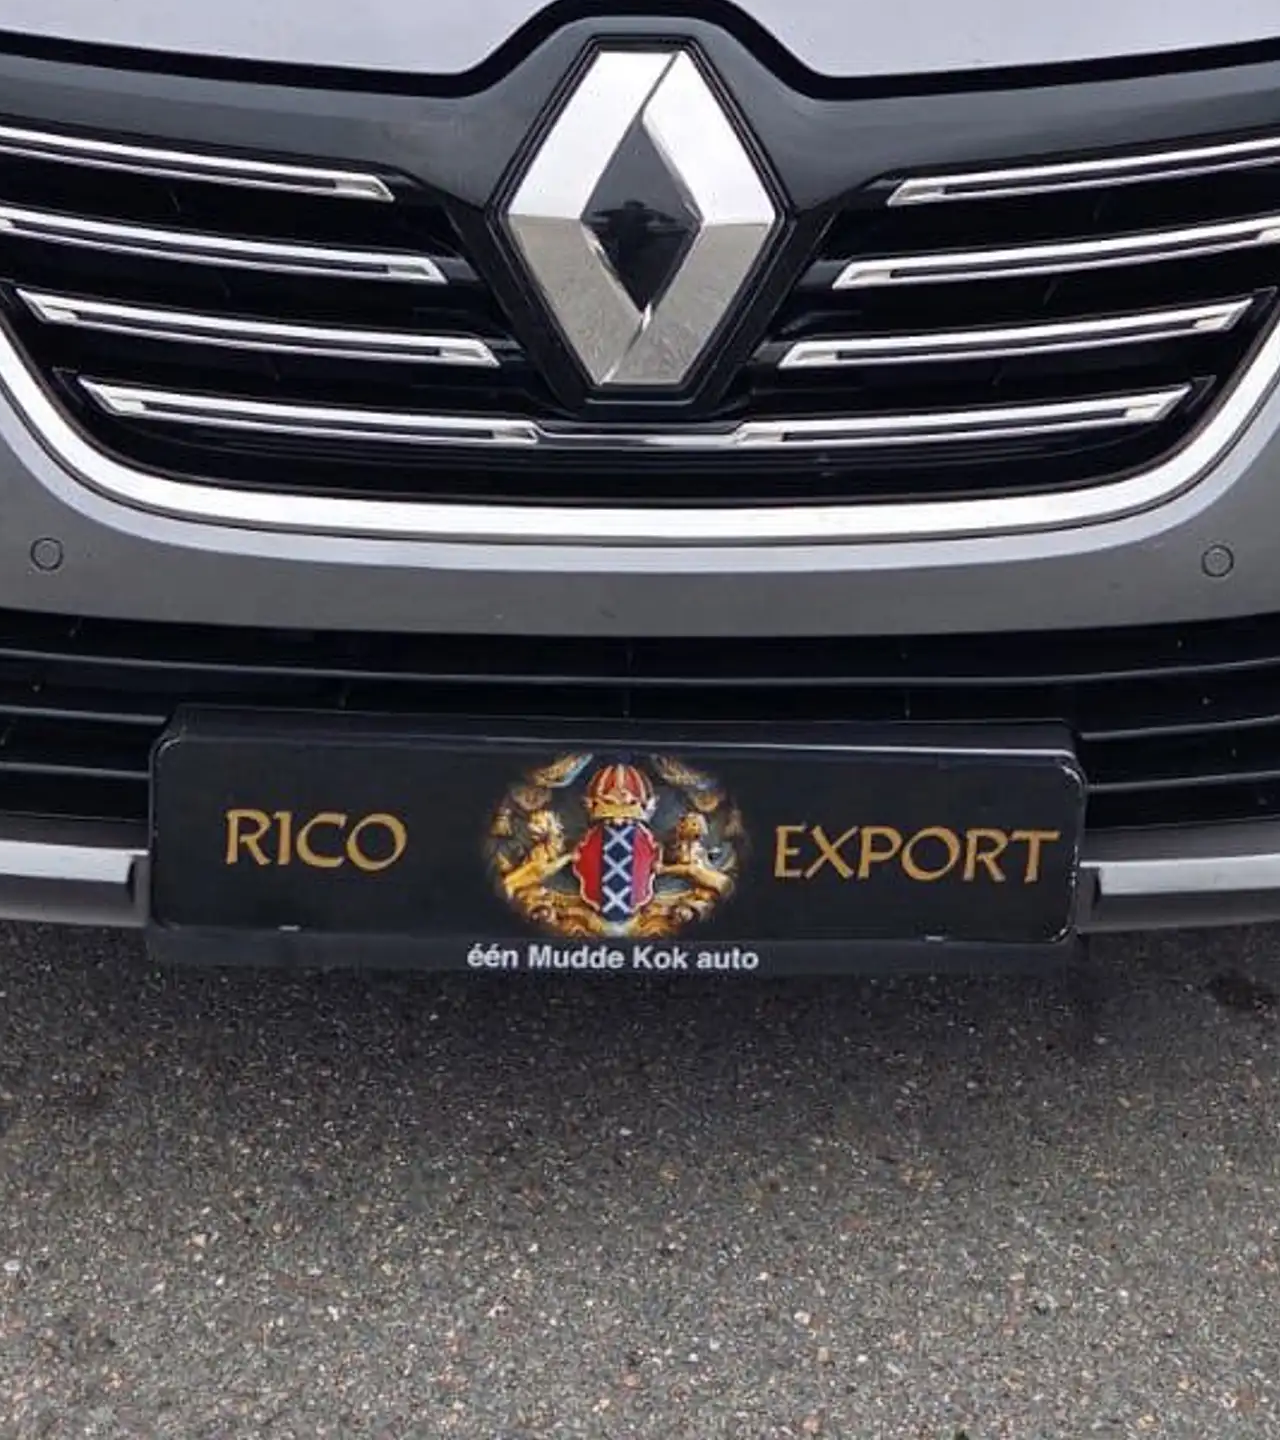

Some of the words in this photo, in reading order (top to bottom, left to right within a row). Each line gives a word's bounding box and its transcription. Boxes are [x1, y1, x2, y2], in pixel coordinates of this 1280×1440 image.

[224, 808, 408, 872] RICO
[773, 824, 1060, 883] EXPORT
[467, 943, 519, 969] één
[527, 944, 625, 970] Mudde
[632, 945, 689, 970] Kok
[696, 947, 759, 971] auto
